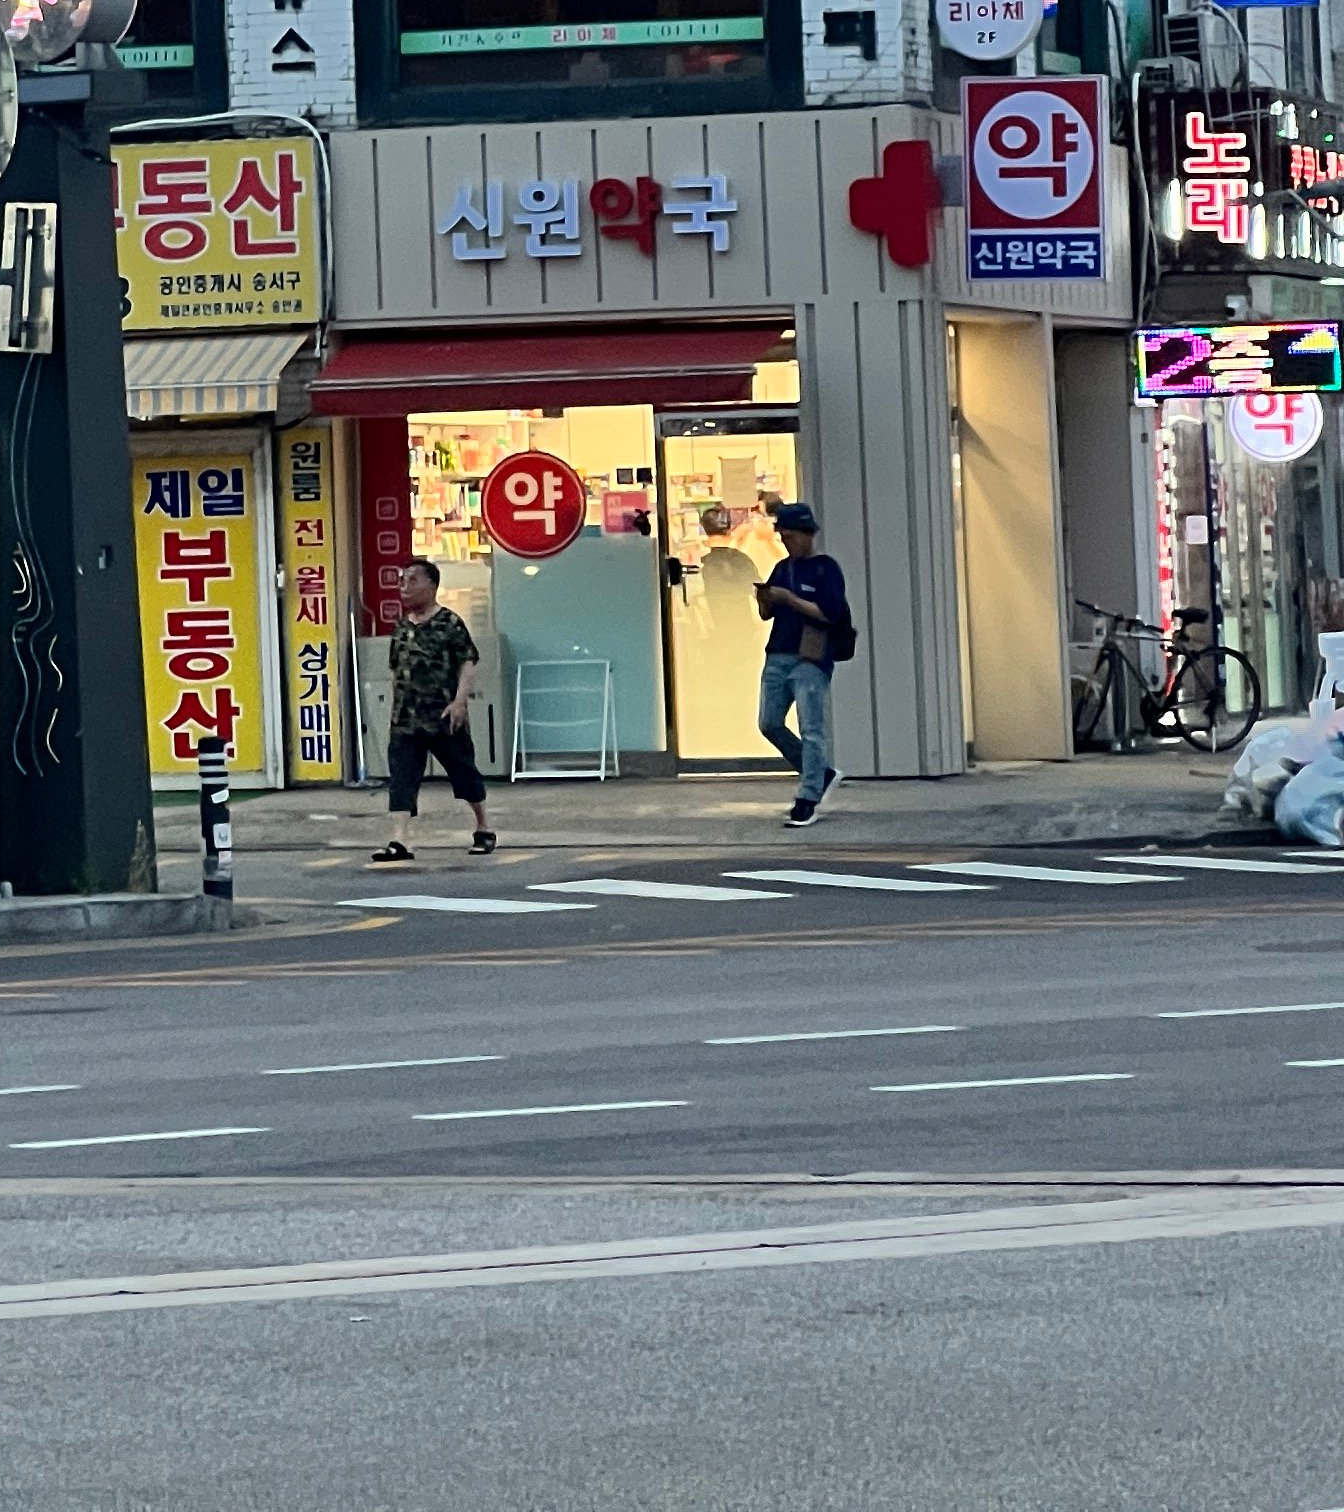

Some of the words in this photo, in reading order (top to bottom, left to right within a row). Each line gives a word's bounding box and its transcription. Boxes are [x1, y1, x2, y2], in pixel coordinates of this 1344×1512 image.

[988, 112, 1080, 199] 약
[1183, 112, 1251, 244] 노래
[437, 174, 738, 261] 신원약국
[975, 242, 1097, 271] 신원약국
[143, 468, 246, 519] 제일
[505, 472, 562, 534] 약
[159, 529, 243, 763] 부동산
[298, 643, 332, 764] 상가매매
